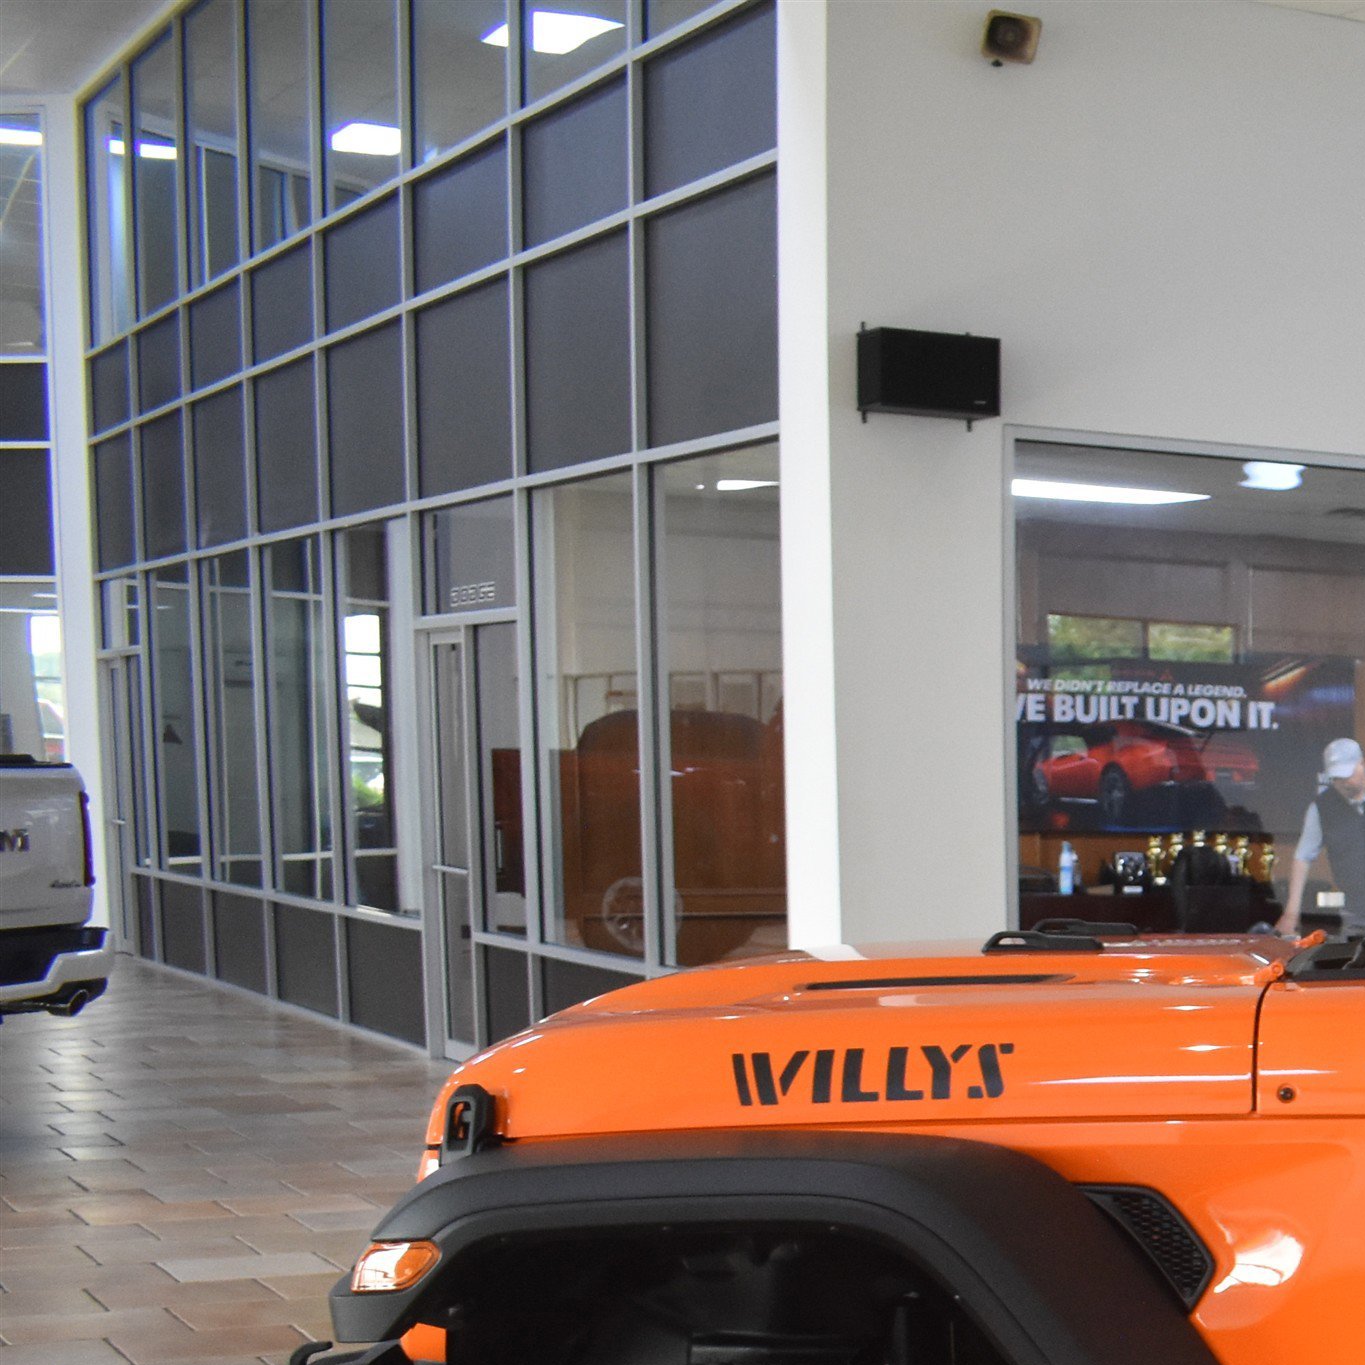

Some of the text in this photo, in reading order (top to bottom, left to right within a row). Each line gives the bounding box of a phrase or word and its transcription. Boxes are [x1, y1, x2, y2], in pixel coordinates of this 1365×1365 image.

[1027, 678, 1247, 698] WE DIDN'T REPLACE A LEGEND.
[1016, 692, 1279, 729] E BUILT UPON IT.
[732, 1043, 1014, 1106] WILLYS
